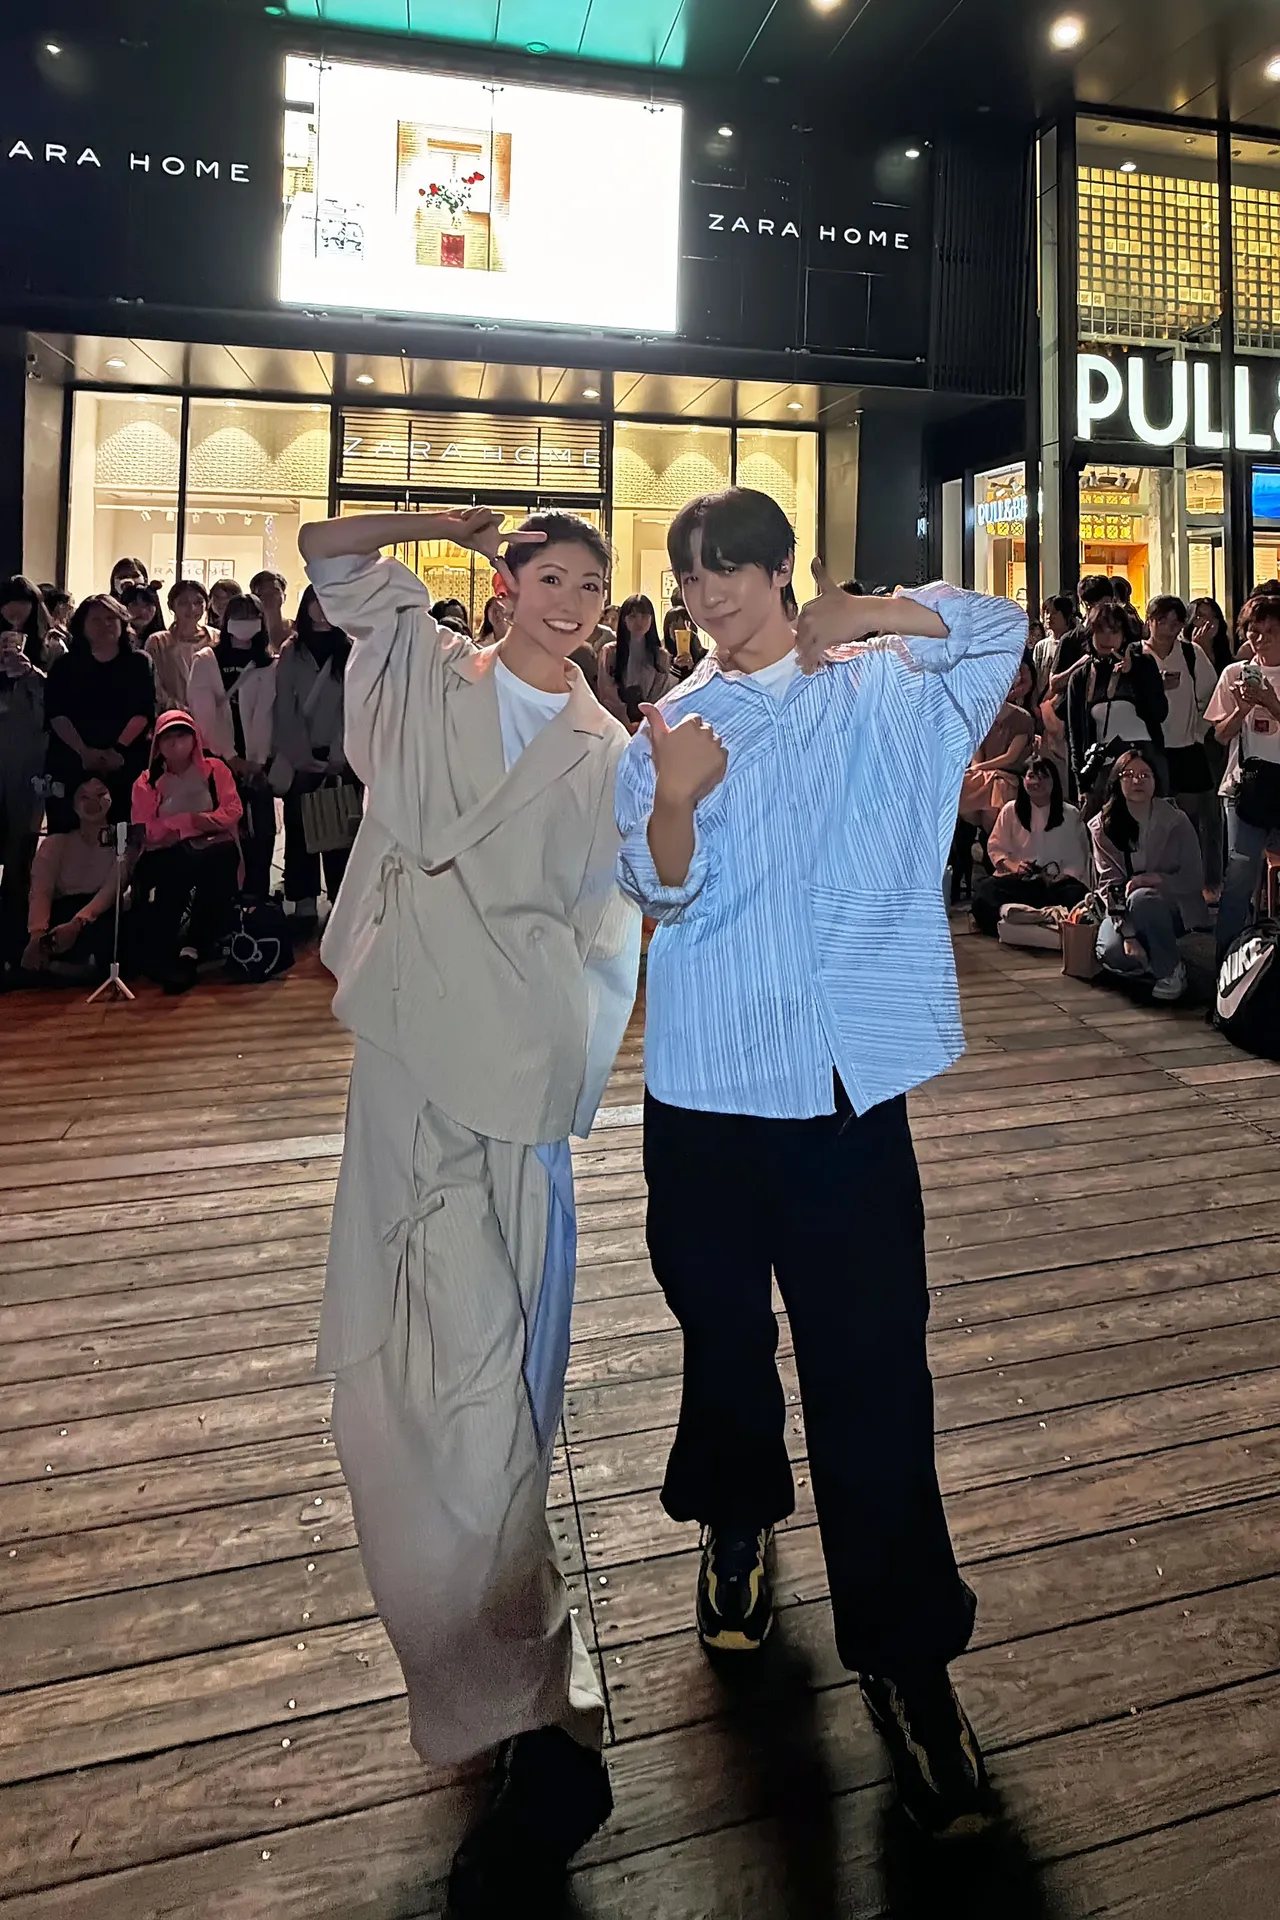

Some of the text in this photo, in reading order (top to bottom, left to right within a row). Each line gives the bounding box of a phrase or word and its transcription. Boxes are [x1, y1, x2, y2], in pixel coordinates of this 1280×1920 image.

[8, 140, 250, 183] ARA HOME
[708, 213, 909, 250] ZARA HOME
[1077, 353, 1280, 451] PULL
[343, 437, 602, 468] ZARA HOME
[1219, 937, 1263, 993] NIKE
